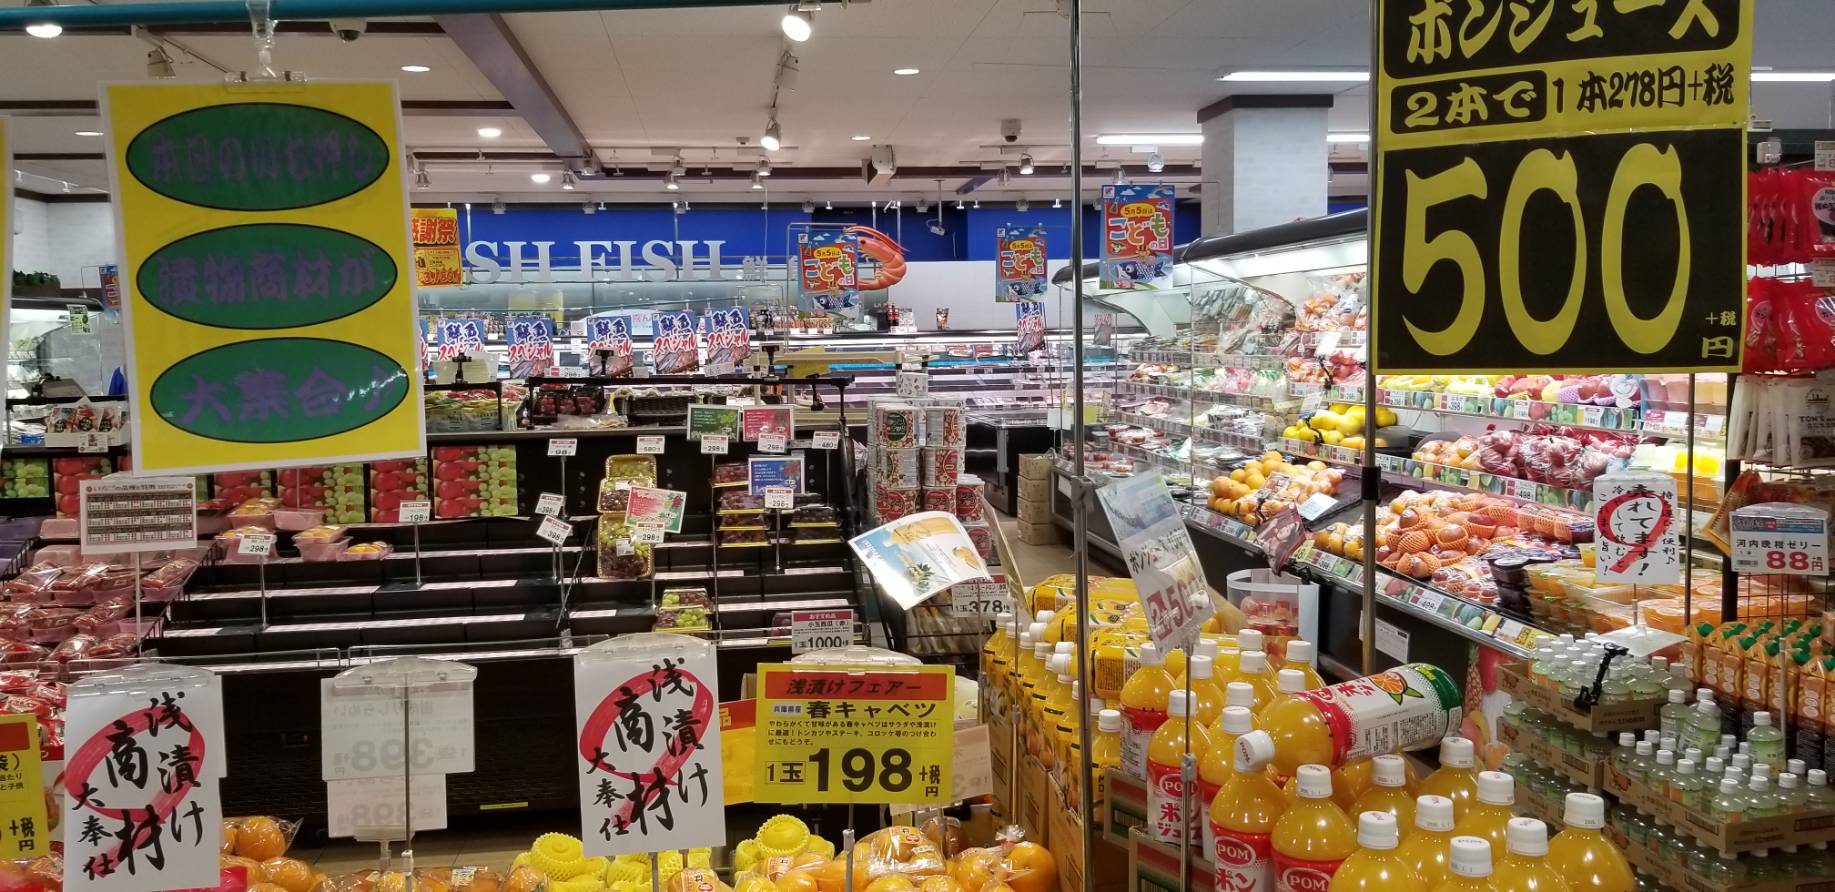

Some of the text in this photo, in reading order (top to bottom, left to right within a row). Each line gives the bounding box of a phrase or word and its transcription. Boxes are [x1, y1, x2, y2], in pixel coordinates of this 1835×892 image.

[1404, 81, 1537, 128] 2本で
[1124, 206, 1153, 215] 5月5日は
[1109, 212, 1169, 245] こども
[1001, 248, 1044, 271] こども
[1402, 142, 1691, 356] 500
[465, 241, 555, 283] SH
[574, 240, 726, 284] FISH
[804, 254, 855, 282] こども
[659, 314, 691, 336] 鮮魚
[711, 309, 745, 331] 鮮魚
[1705, 310, 1737, 326] +税
[445, 322, 482, 343] 鮮魚
[514, 321, 548, 344] 鮮魚
[594, 319, 627, 341] 鮮魚
[708, 330, 750, 350] スペシャル
[509, 342, 554, 363] スペシャル
[655, 334, 697, 353] スペシャル
[1701, 336, 1734, 359] 円
[547, 530, 560, 541] 398
[1736, 539, 1821, 550] 河内晩柑ゼリー
[1766, 550, 1809, 571] 88
[1811, 561, 1823, 572] 円
[969, 600, 1003, 613] 378
[808, 636, 842, 649] 1000
[786, 679, 921, 695] 浅漬けフェアー
[773, 701, 936, 719] 兵庫県産 春キャベツ
[647, 657, 708, 808] 浅漬け
[768, 738, 814, 746] せにもどうぞ。
[144, 691, 205, 847] 浅漬け
[614, 686, 674, 836] 商材
[767, 762, 804, 783] 1玉
[808, 747, 913, 793] 198
[105, 719, 165, 875] 商材
[585, 747, 629, 841] 大奉仕
[925, 786, 938, 797] 円
[71, 783, 116, 881] 大奉仕
[18, 839, 35, 851] 円
[1217, 843, 1249, 861] POM
[1216, 867, 1256, 892] ポン
[1289, 874, 1327, 891] POM
